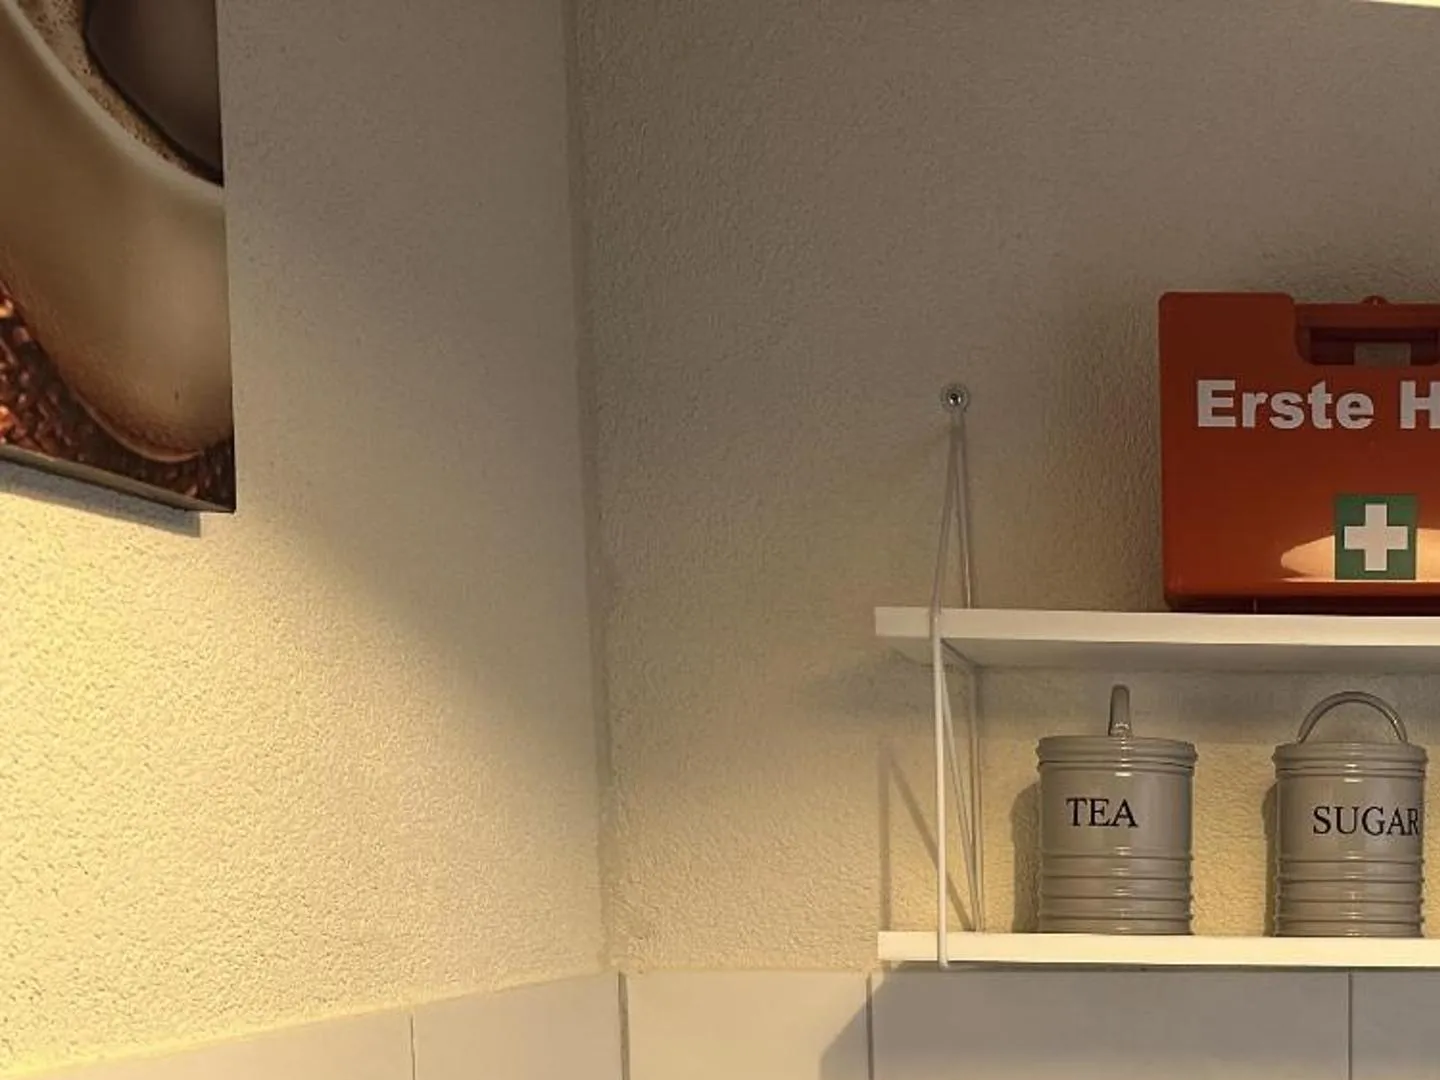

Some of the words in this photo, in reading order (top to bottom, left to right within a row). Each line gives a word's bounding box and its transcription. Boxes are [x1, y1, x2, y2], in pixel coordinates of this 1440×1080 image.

[1197, 379, 1375, 430] Erste
[1065, 797, 1138, 828] TEA
[1312, 805, 1419, 837] SUGAR
